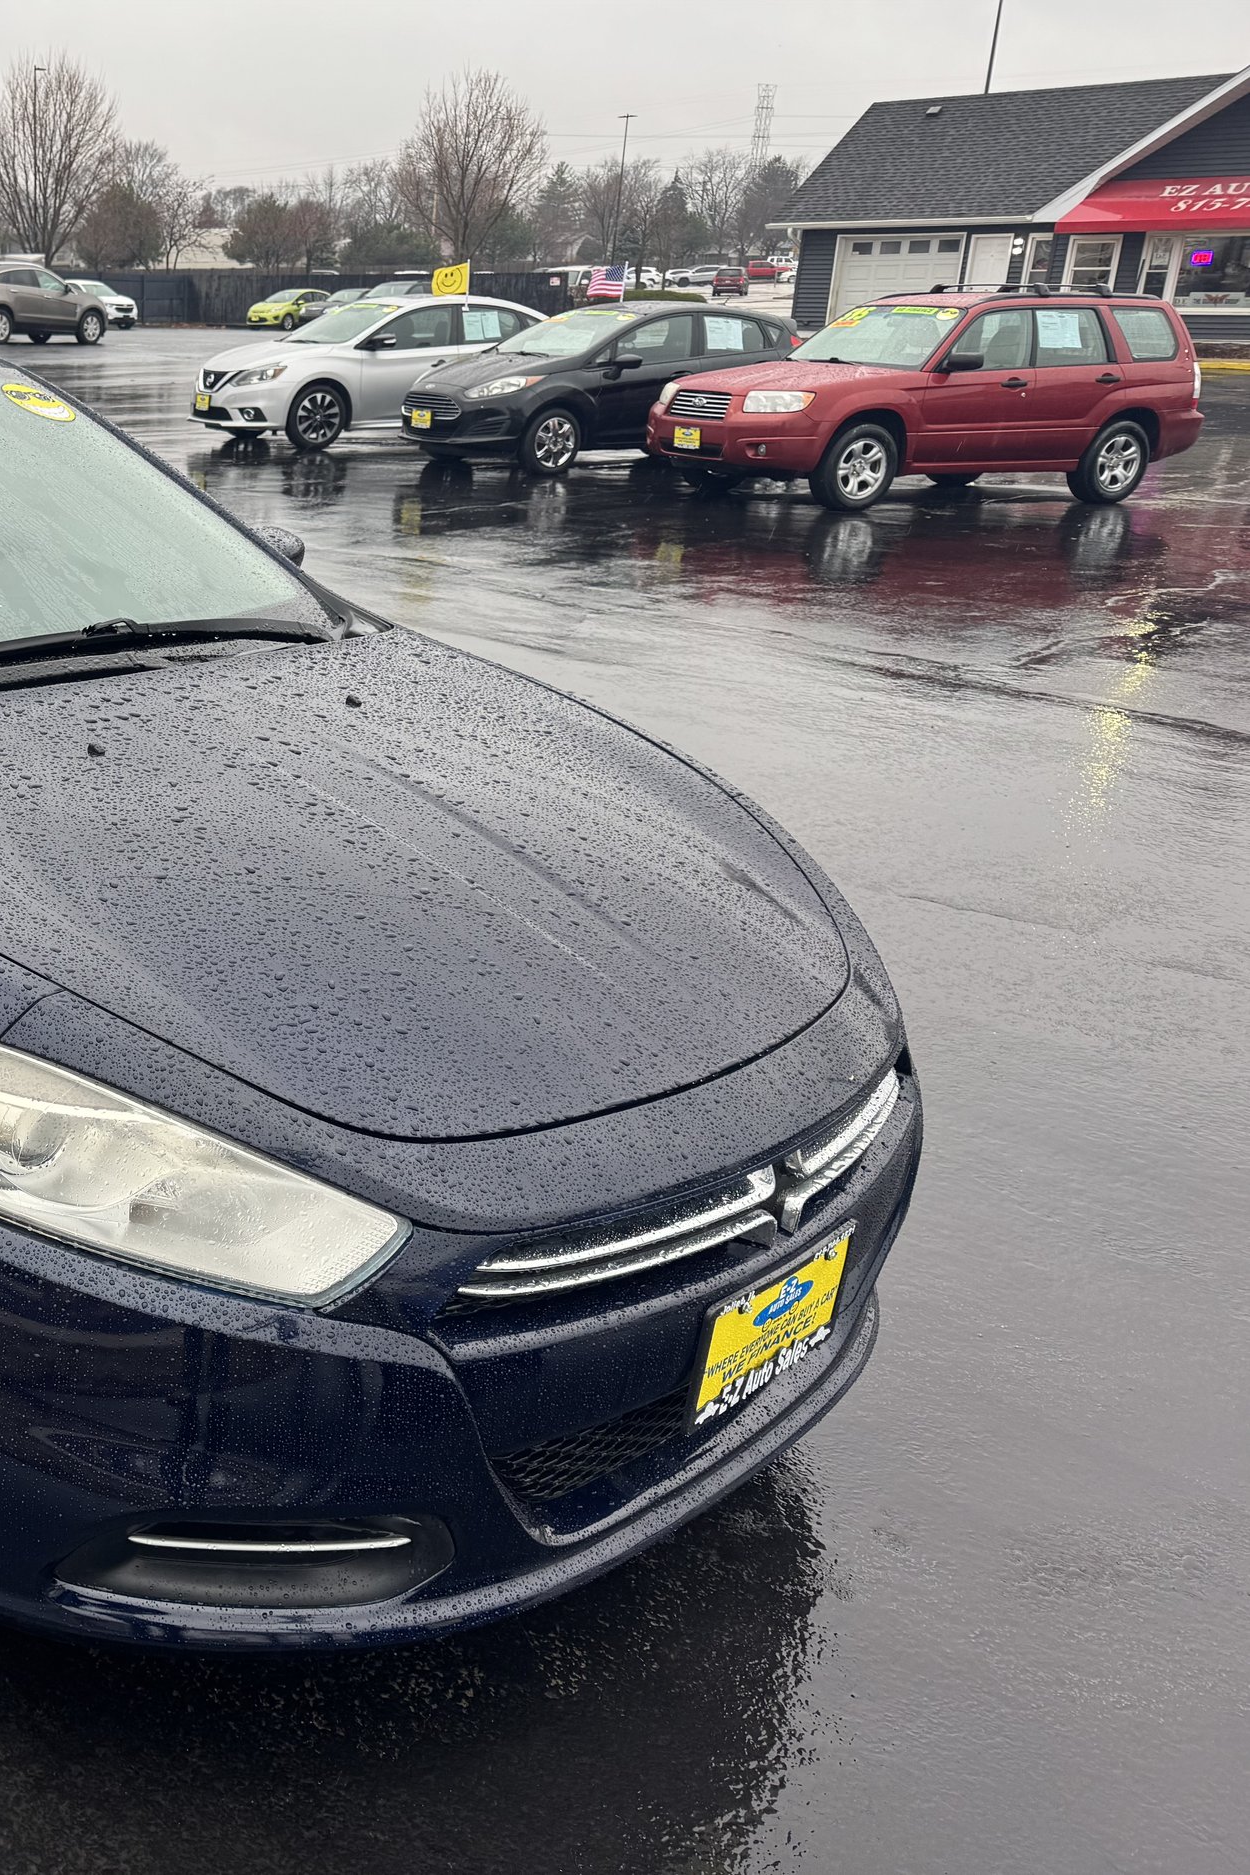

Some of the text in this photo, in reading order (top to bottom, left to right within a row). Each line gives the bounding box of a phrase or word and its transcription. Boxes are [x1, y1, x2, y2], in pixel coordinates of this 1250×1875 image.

[1159, 182, 1250, 197] EZ AU
[1170, 197, 1250, 212] 815-7
[768, 1286, 802, 1314] AUTO SALES
[722, 1312, 817, 1383] WE FINANCE!
[740, 1323, 780, 1358] EVERYONE
[781, 1313, 798, 1330] CAN
[798, 1301, 815, 1321] BUY
[813, 1298, 820, 1311] A
[741, 1360, 774, 1400] Auto
[774, 1337, 810, 1376] Sales
